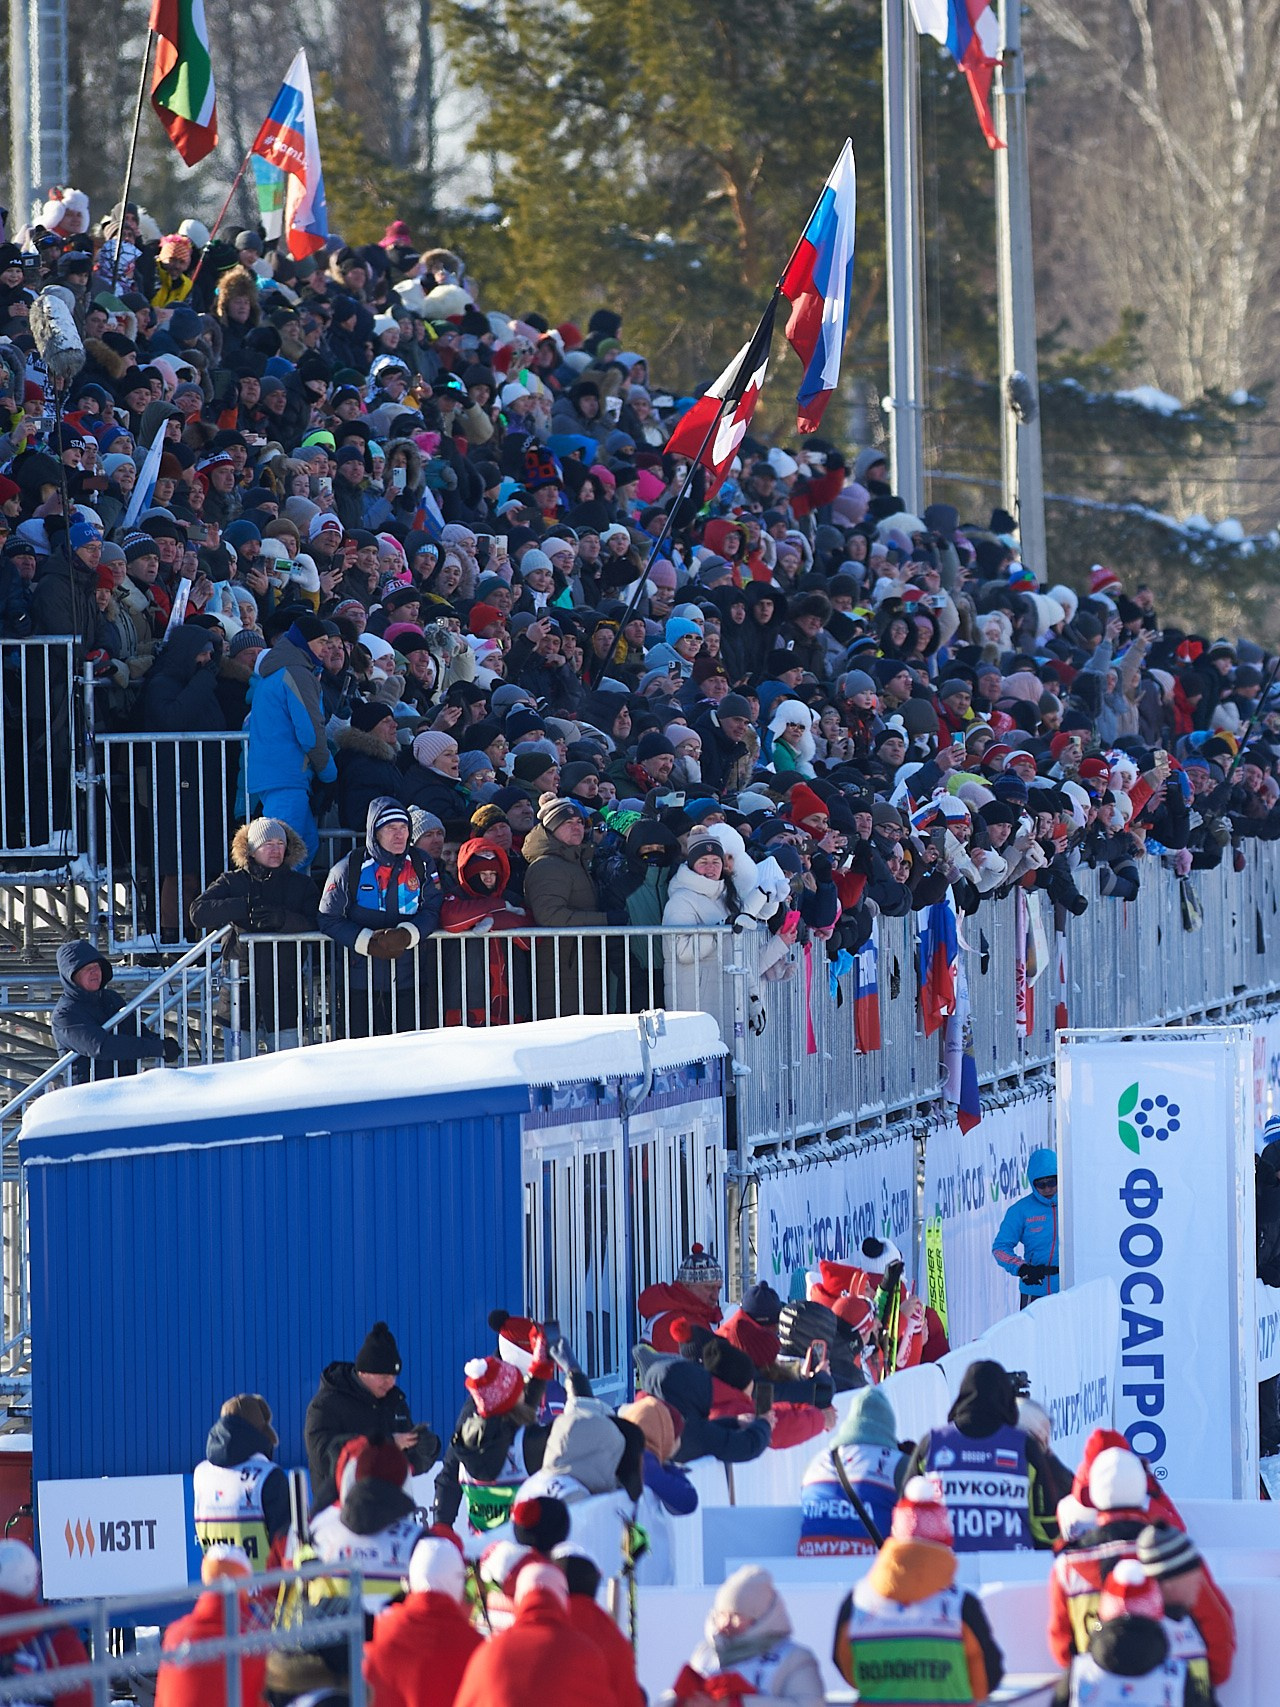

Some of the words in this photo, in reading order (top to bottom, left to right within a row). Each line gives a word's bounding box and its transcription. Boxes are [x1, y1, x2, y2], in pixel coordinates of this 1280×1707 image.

[935, 1248, 946, 1313] FISCHER
[240, 1467, 263, 1482] 57
[944, 1480, 1025, 1498] ЛУКОЙЛ
[100, 1519, 157, 1552] ИЗТТ
